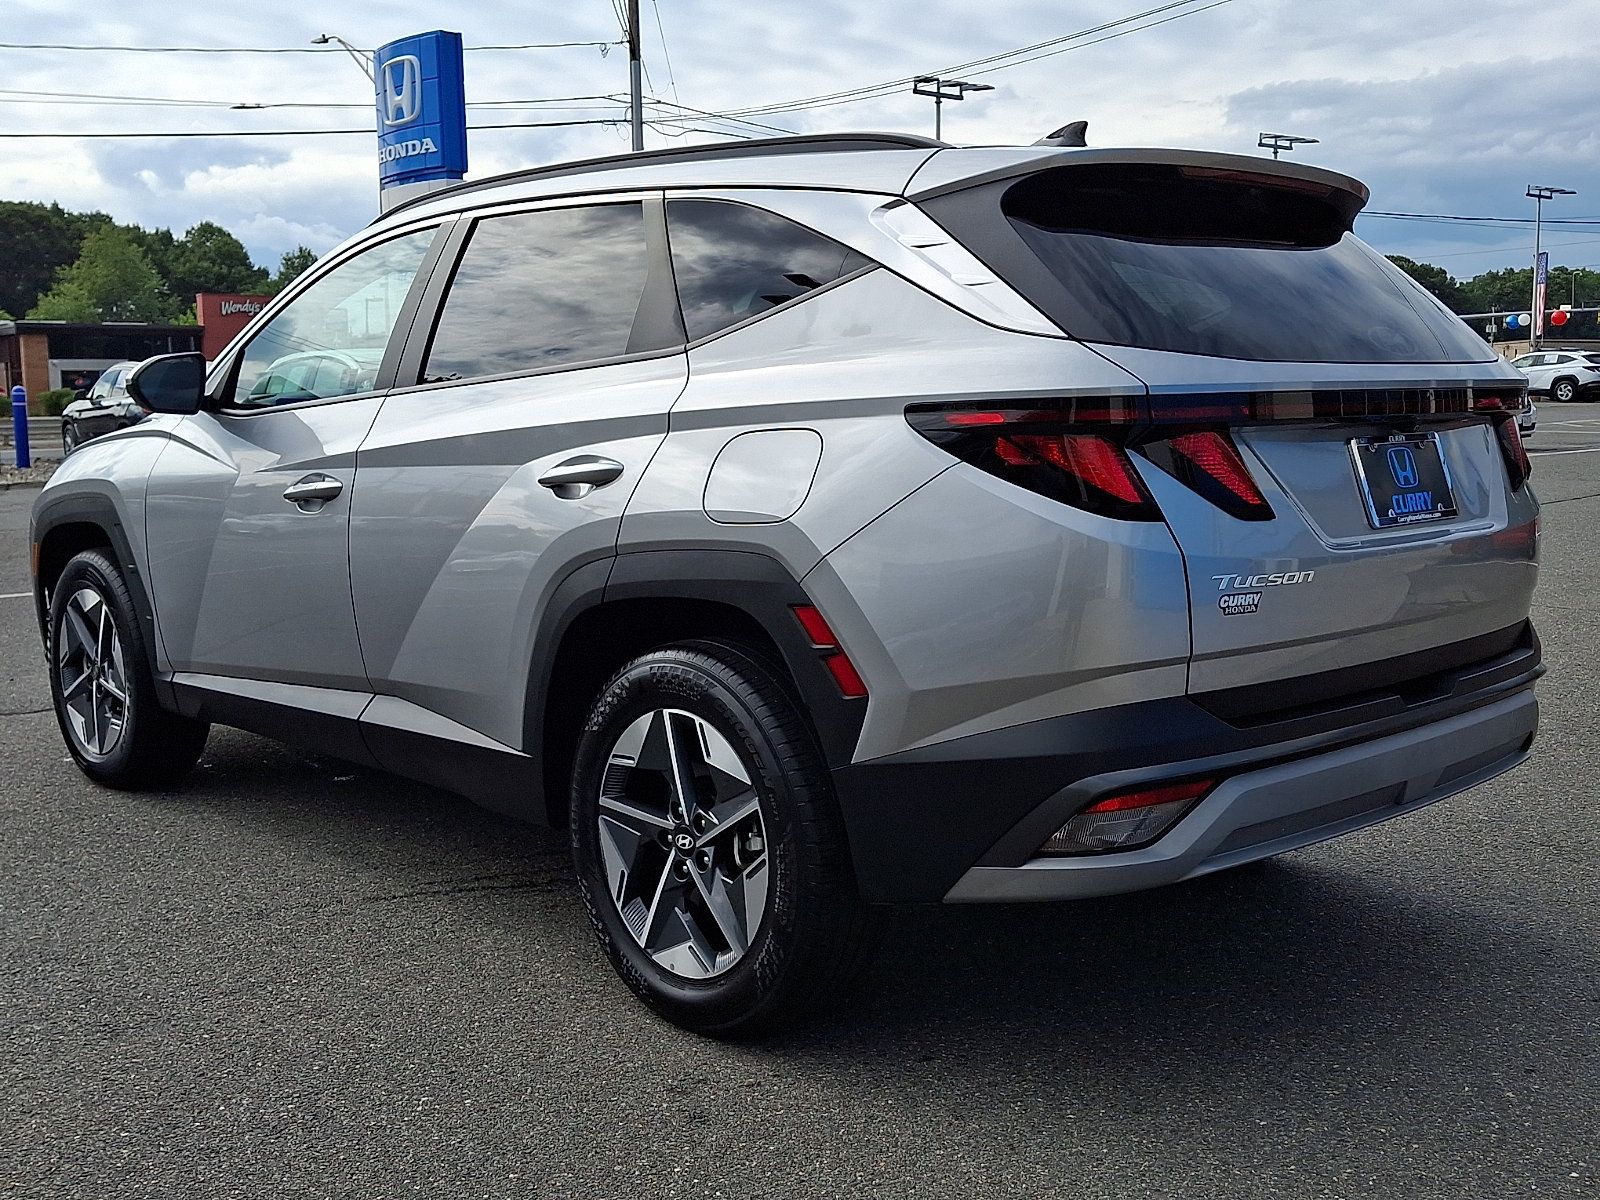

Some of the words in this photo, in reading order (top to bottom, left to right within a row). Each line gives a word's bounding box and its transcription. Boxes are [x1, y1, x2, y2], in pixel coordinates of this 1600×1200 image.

[379, 137, 438, 164] HONDA
[221, 300, 261, 316] Wendy's
[1392, 491, 1432, 513] CURRY
[1220, 593, 1261, 607] CURRY
[1225, 605, 1256, 614] HONDA
